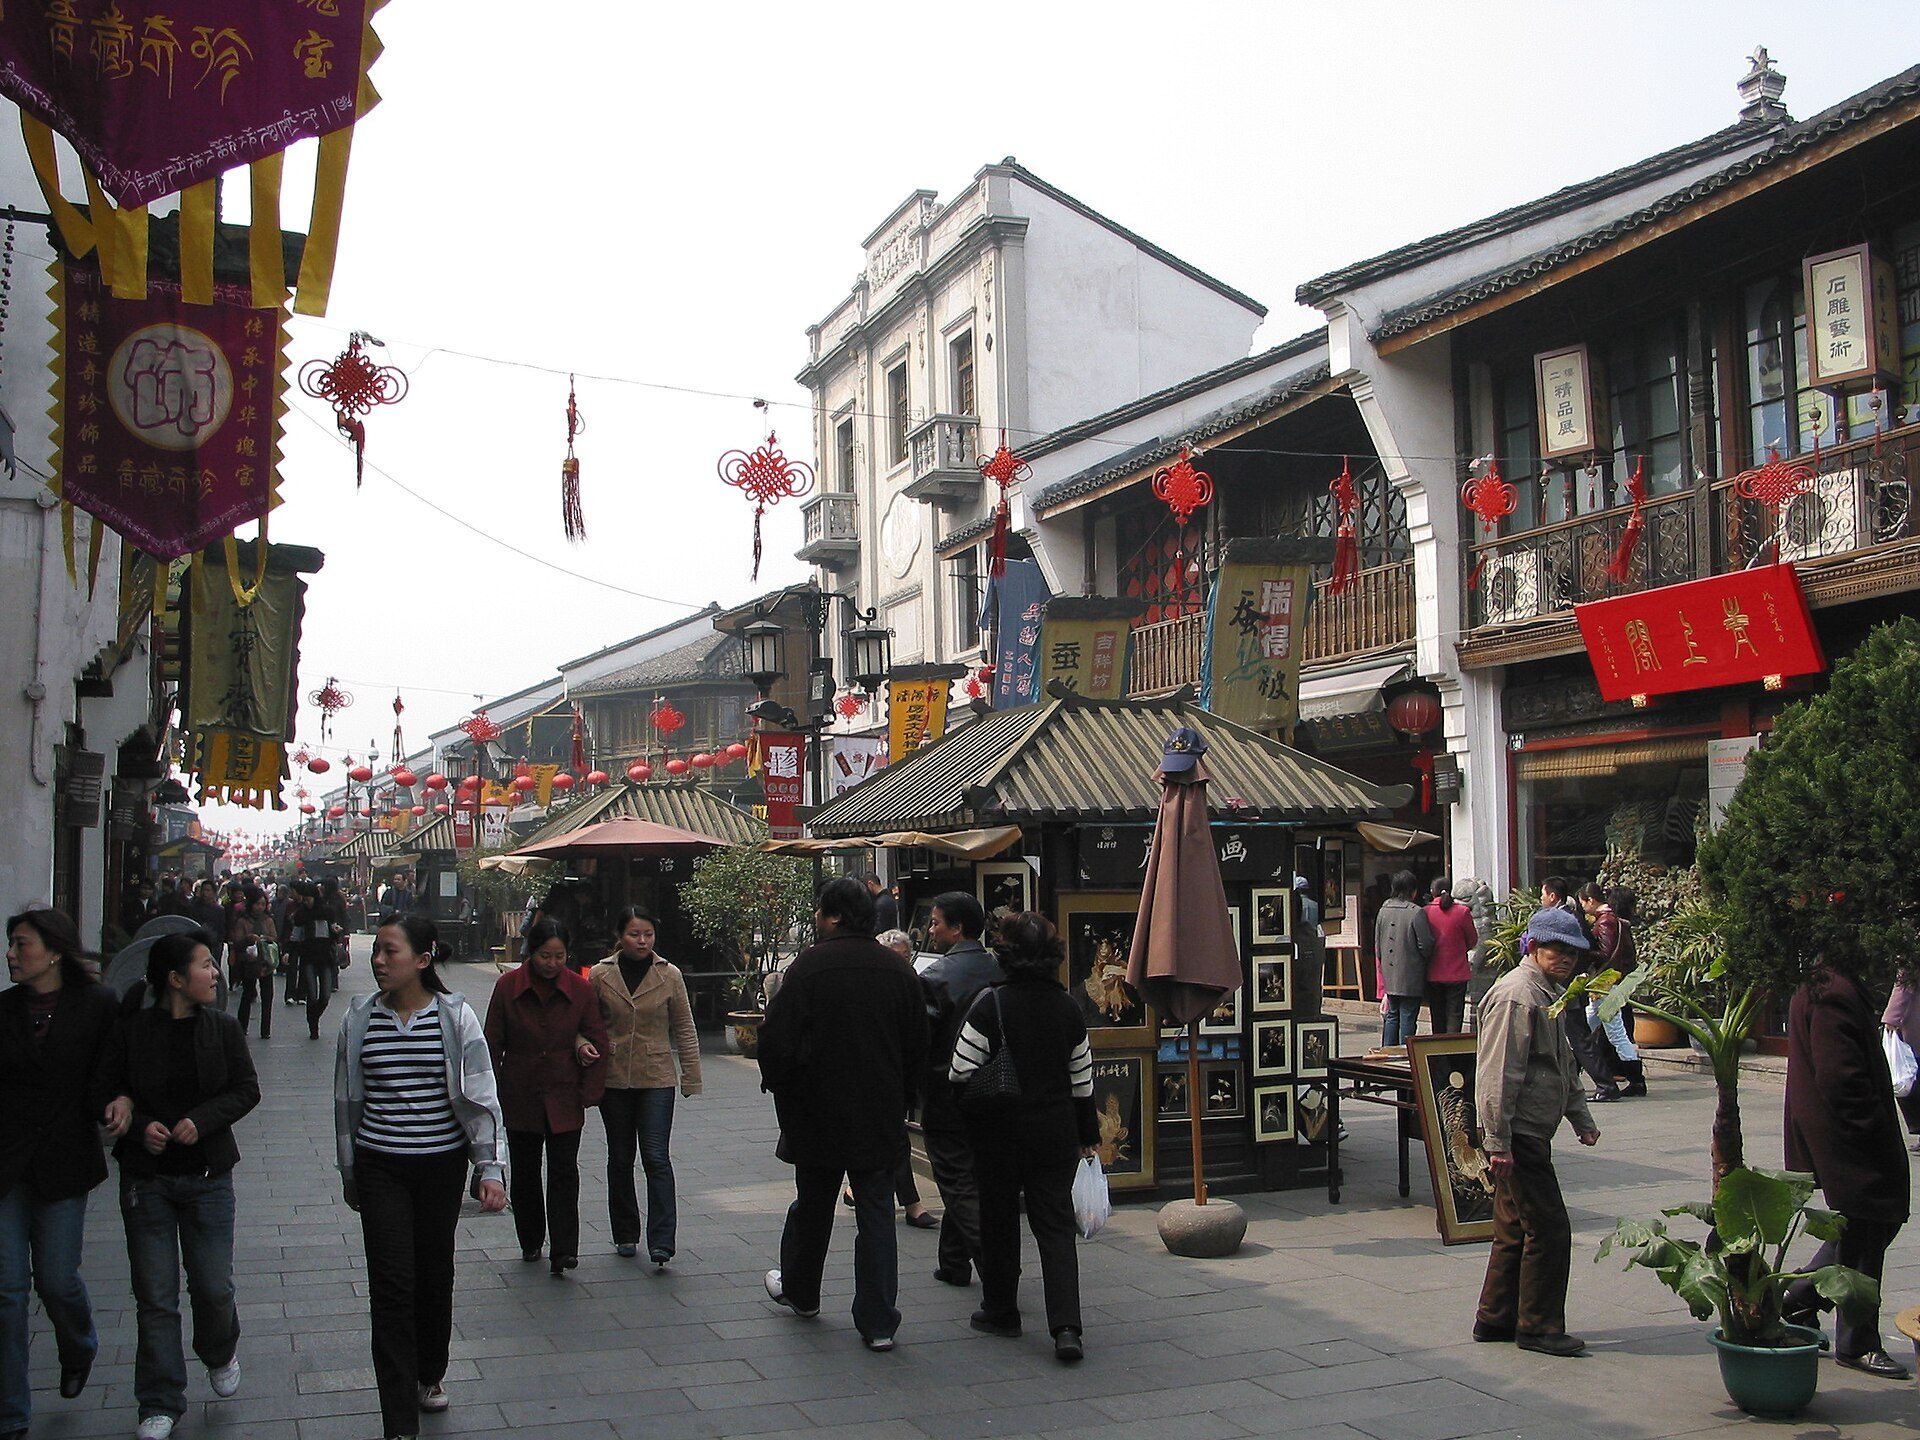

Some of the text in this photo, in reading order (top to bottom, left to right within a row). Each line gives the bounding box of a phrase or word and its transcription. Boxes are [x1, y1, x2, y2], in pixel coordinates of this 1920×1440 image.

[1827, 276, 1851, 358] 石雕藝術
[1261, 580, 1290, 658] 瑞得
[1091, 633, 1117, 688] 吉祥坊
[903, 704, 926, 757] 历史文化特
